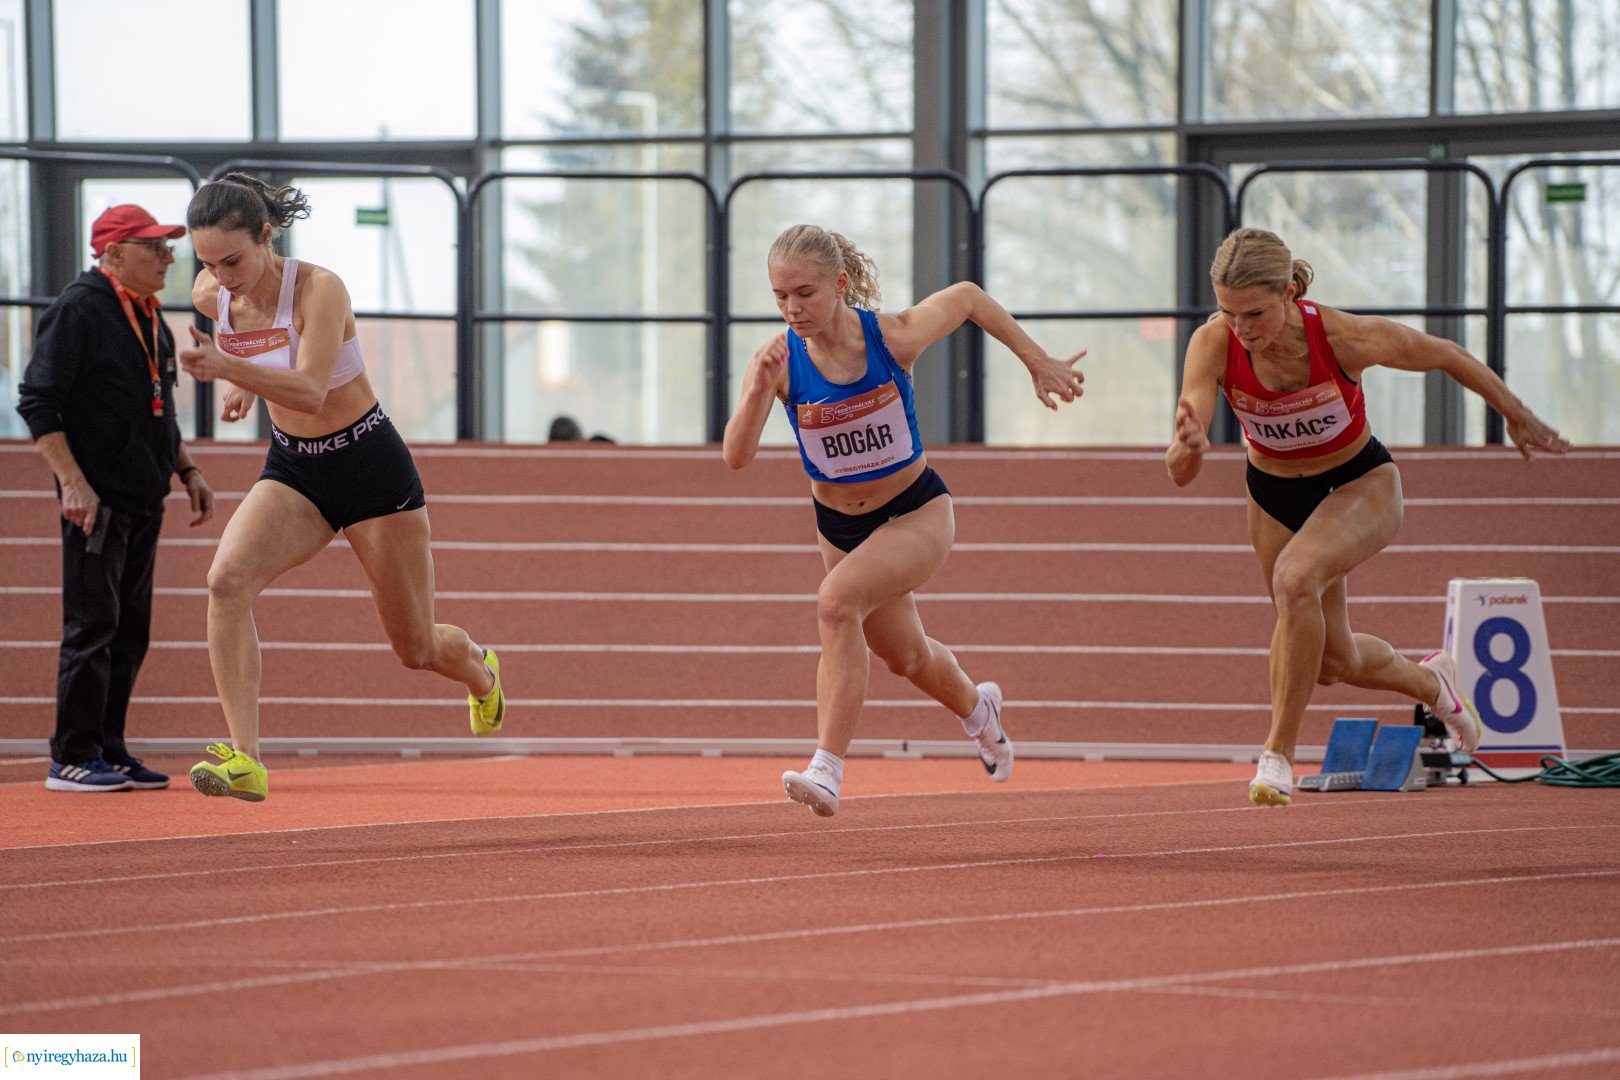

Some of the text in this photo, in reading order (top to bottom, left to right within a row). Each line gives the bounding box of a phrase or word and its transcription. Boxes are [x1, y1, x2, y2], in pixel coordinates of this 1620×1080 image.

[298, 432, 349, 454] NIKE
[352, 407, 385, 440] PRO
[821, 424, 893, 459] BOGÁR
[1250, 415, 1337, 439] TAKÁCS
[835, 455, 895, 474] NYÍREGYHÁZA 2024
[1489, 595, 1528, 606] polanik
[1474, 616, 1536, 733] 8
